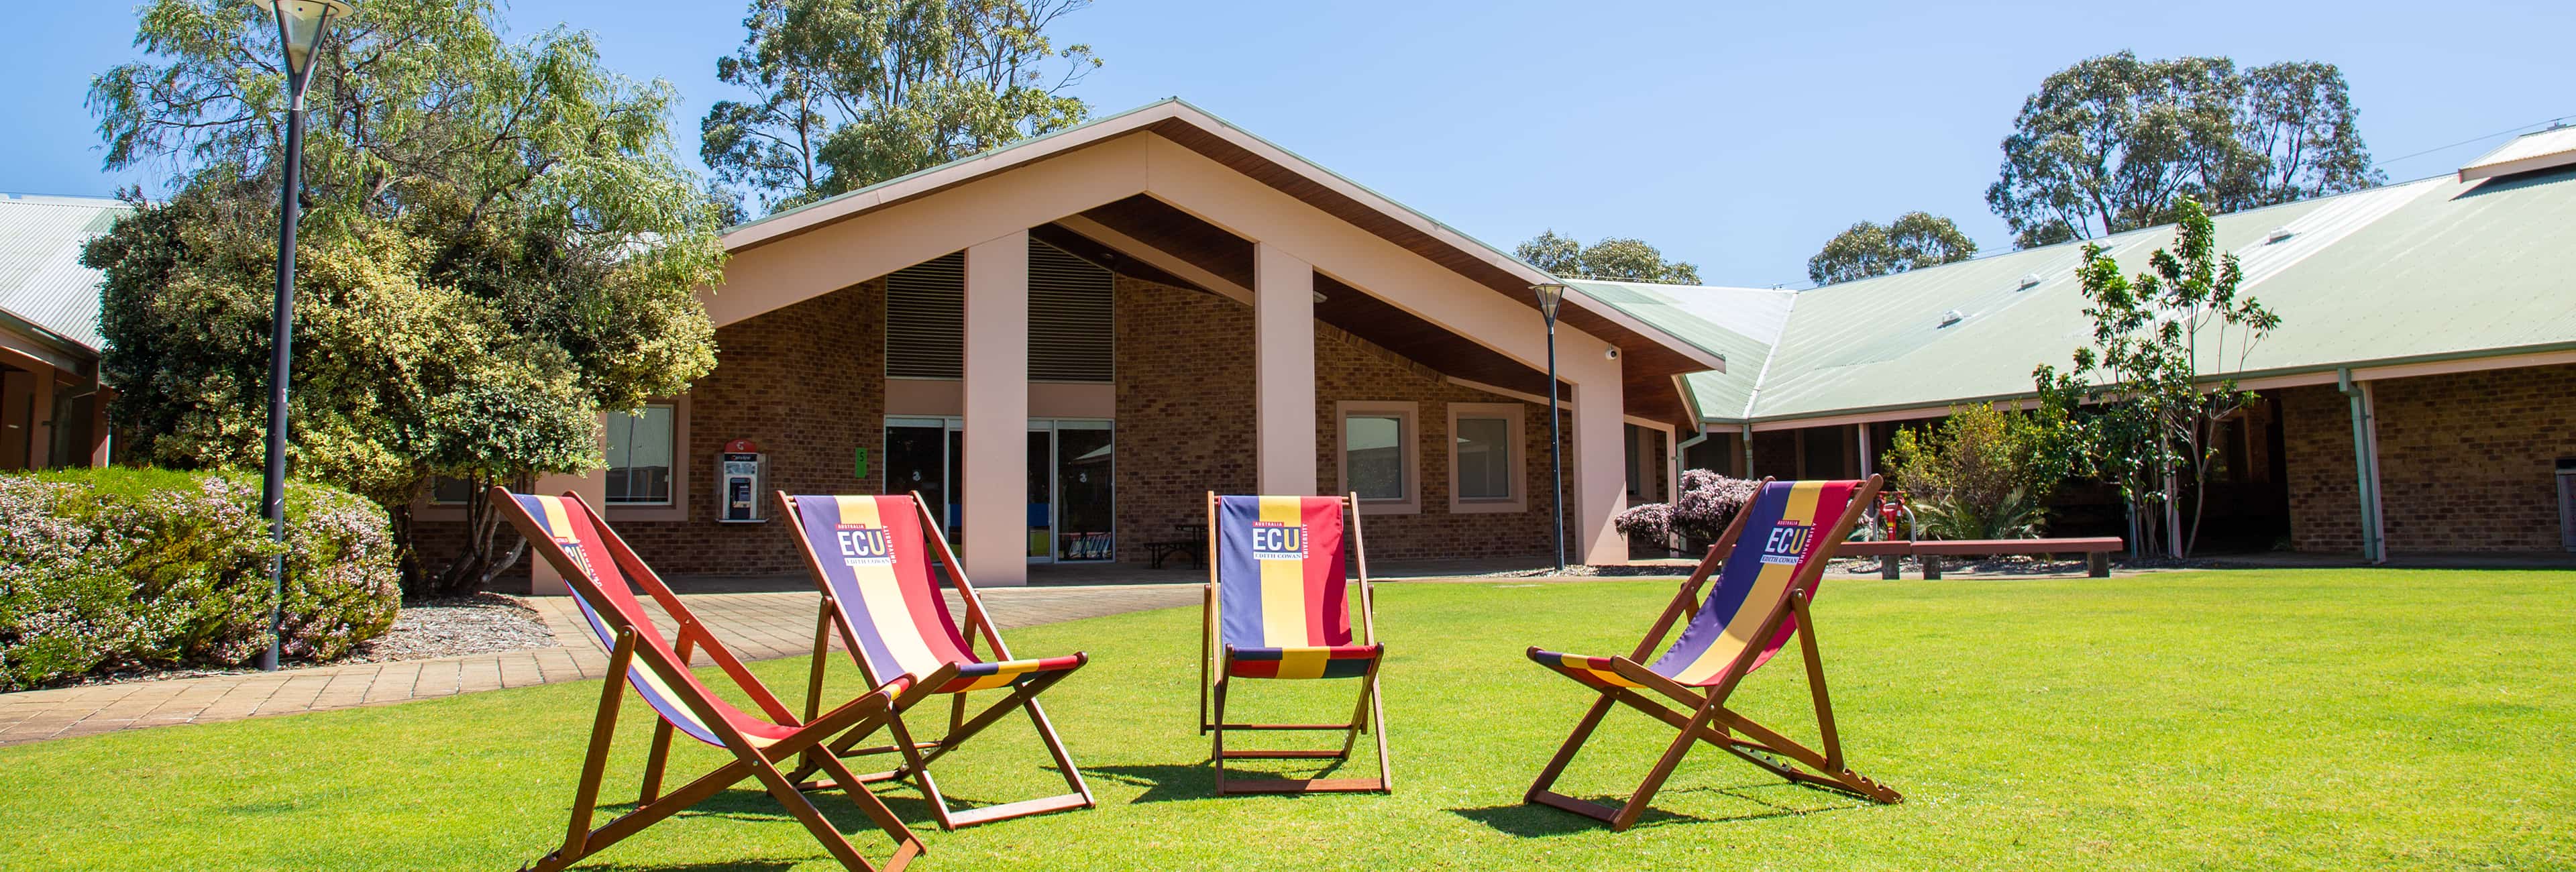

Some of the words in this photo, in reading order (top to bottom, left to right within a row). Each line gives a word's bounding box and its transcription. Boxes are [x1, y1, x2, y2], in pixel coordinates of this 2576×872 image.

[860, 451, 865, 461] 5
[837, 531, 885, 556] ECU
[882, 525, 897, 563] UNIVERSITY
[1252, 528, 1299, 551] ECU
[1764, 527, 1809, 554] ECU
[1798, 523, 1817, 563] UNIVERSITY
